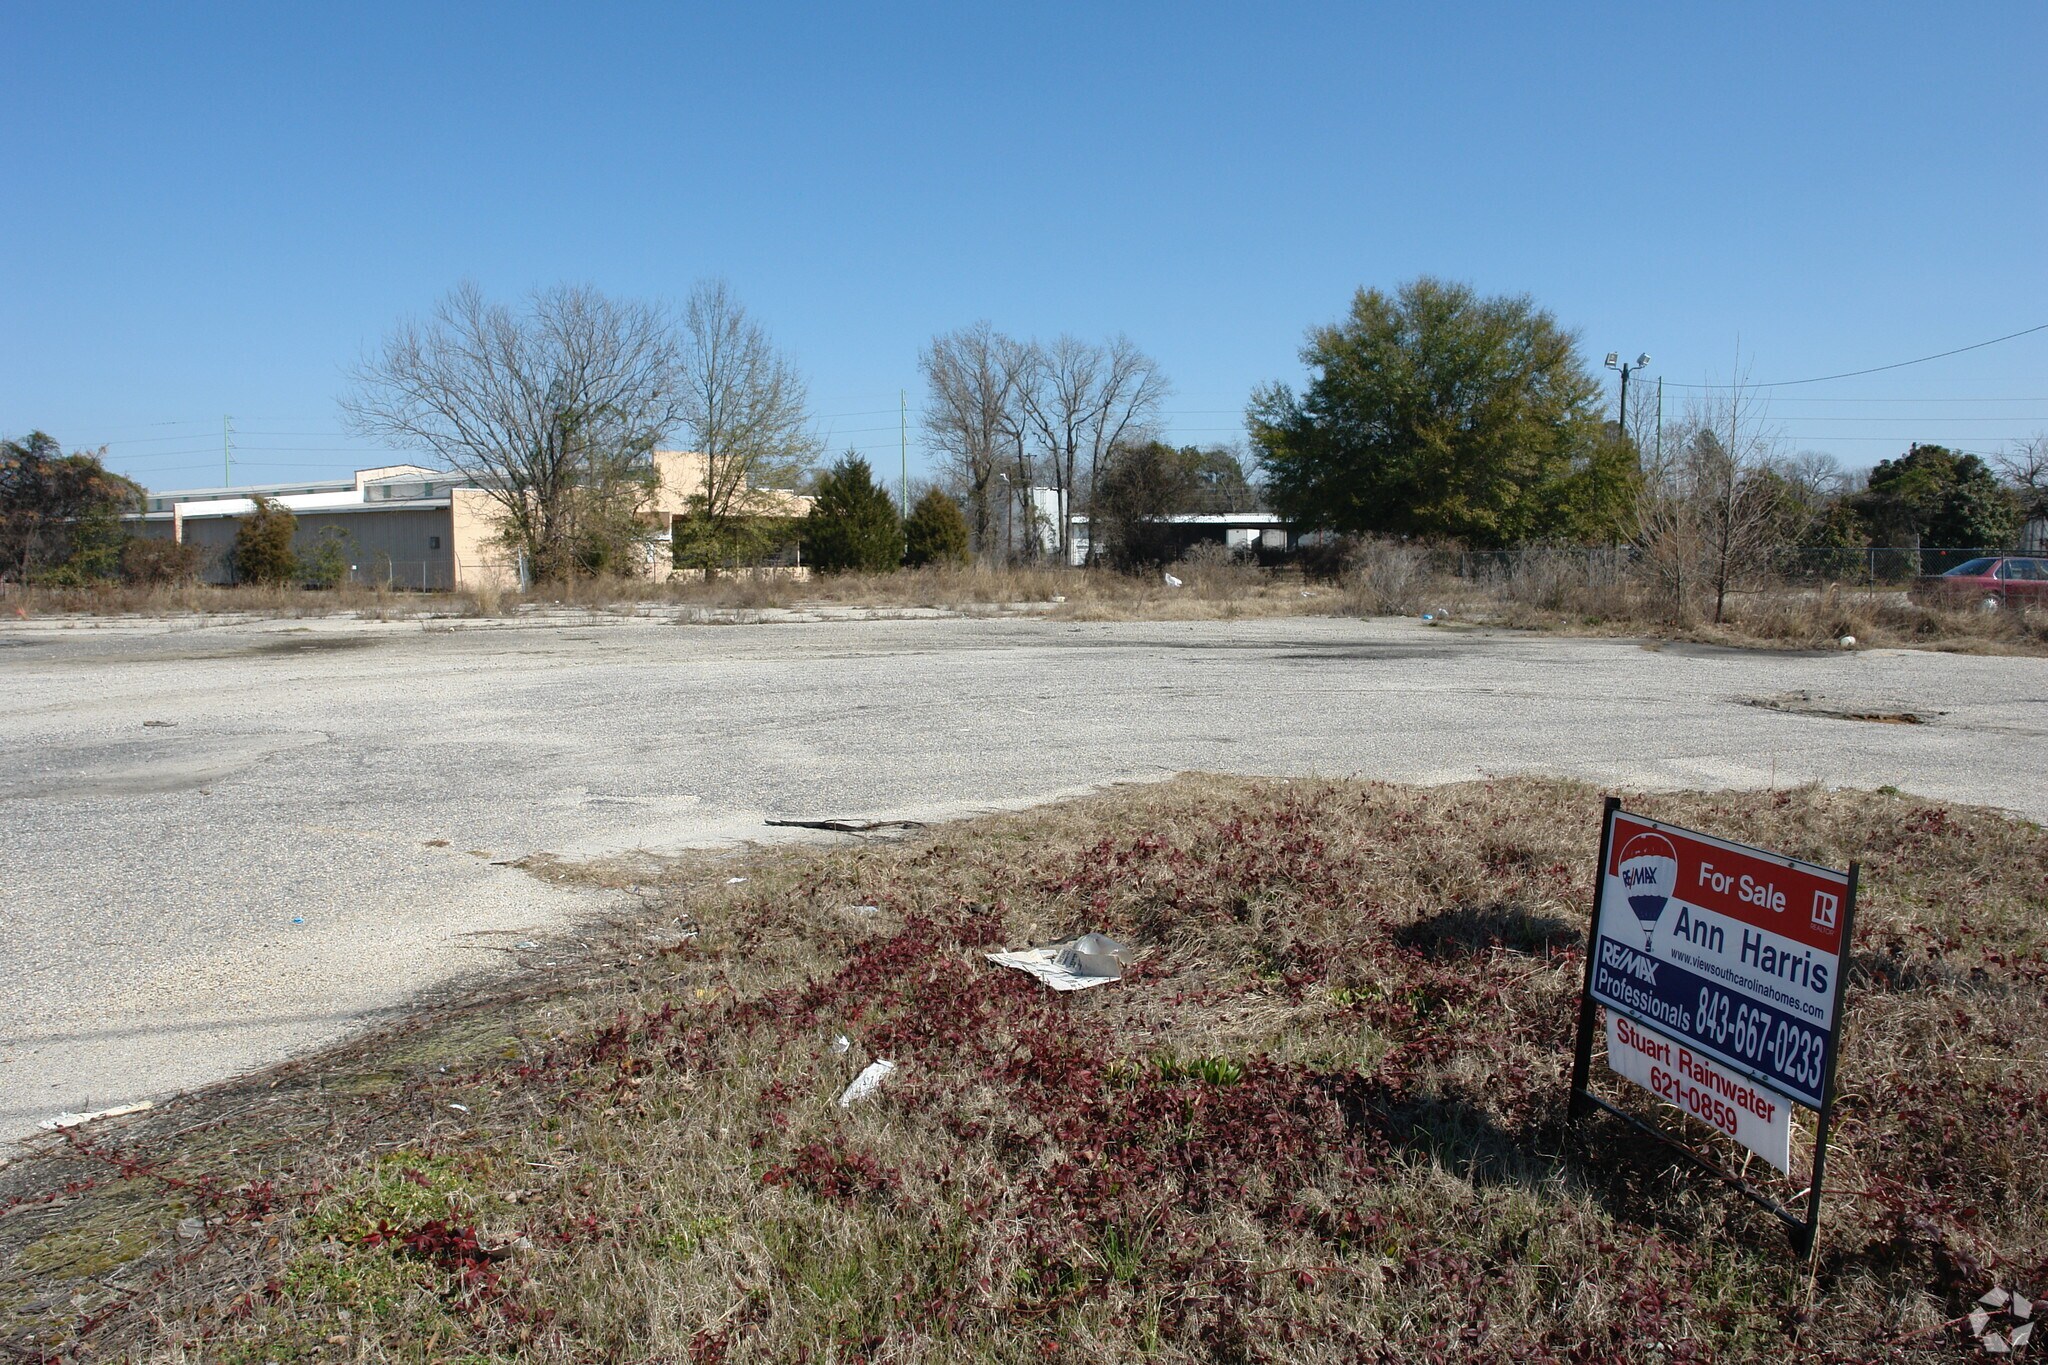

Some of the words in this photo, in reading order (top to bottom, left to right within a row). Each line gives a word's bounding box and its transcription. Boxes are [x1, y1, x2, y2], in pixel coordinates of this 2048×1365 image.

[1622, 866, 1657, 890] RE/MAX
[1698, 861, 1734, 896] For
[1738, 874, 1786, 914] Sale
[1601, 941, 1660, 987] RE/MAX
[1670, 948, 1825, 1021] www.viewsouthcarolinahomes.com
[1673, 906, 1725, 954] Ann
[1740, 928, 1829, 994] Harris
[1598, 968, 1692, 1033] Professionals
[1616, 1018, 1671, 1067] Stuart
[1678, 1047, 1776, 1124] Rainwater
[1695, 986, 1825, 1090] 843-667-0233
[1650, 1066, 1738, 1136] 621-0859
